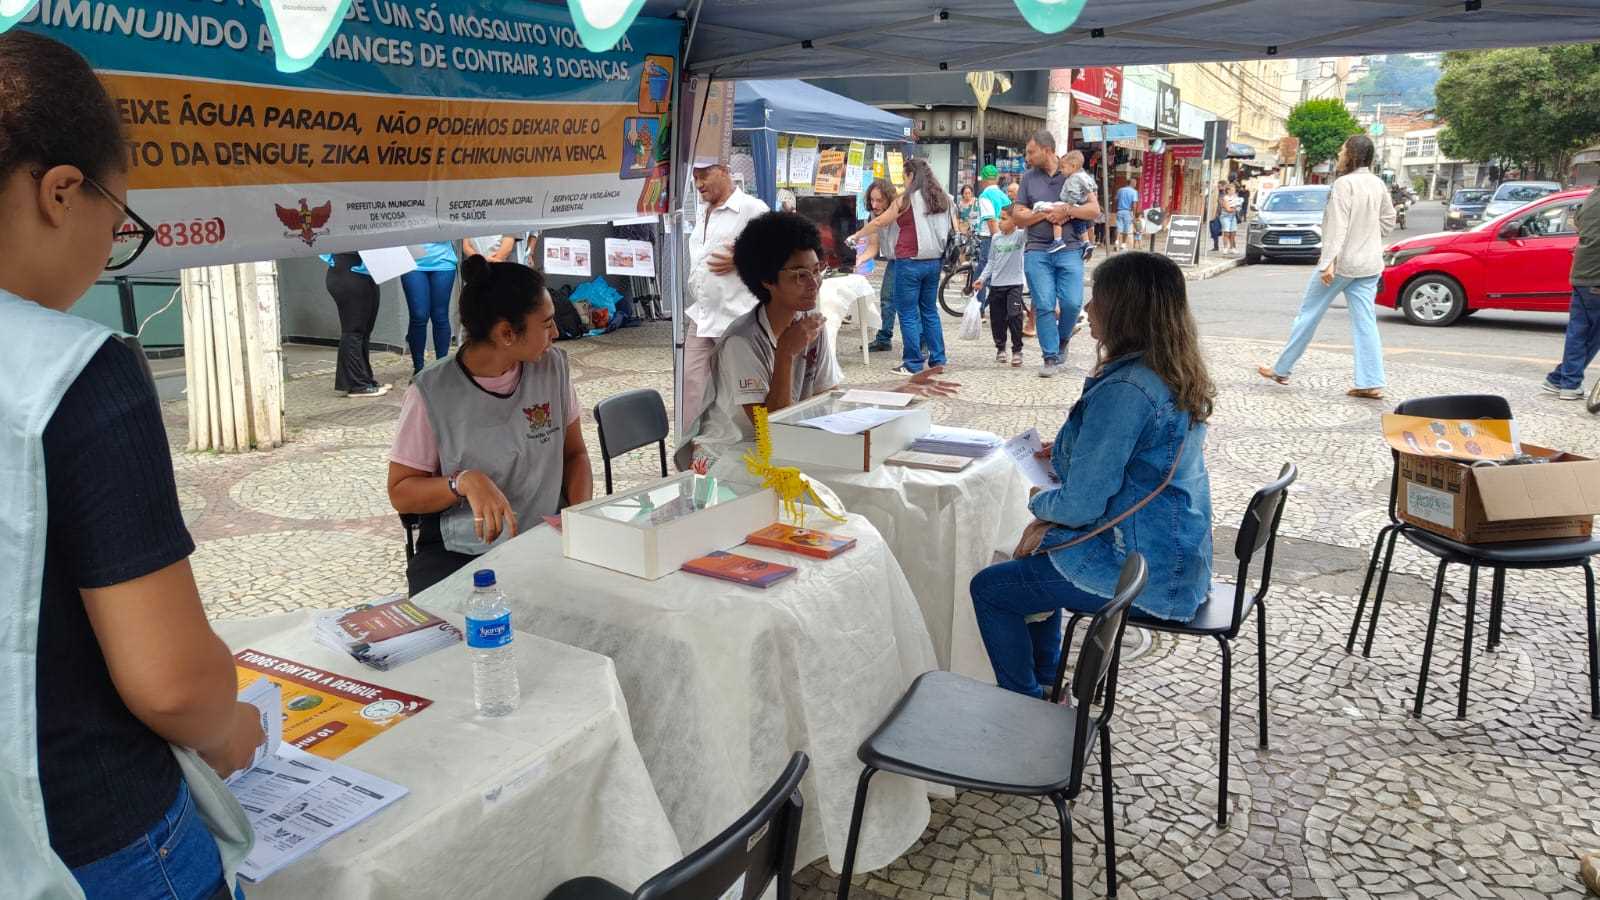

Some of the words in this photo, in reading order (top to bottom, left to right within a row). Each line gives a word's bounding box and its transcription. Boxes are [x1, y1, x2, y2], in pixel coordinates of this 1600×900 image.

[373, 0, 414, 29] UM
[415, 3, 445, 34] SÓ
[449, 13, 547, 45] MOSQUITO
[549, 26, 586, 48] VOC
[257, 23, 275, 52] A
[328, 33, 415, 66] ANCES
[420, 42, 448, 69] DE
[452, 46, 539, 76] CONTRAIR
[543, 55, 553, 77] 3
[556, 57, 631, 82] DOENÇAS.
[114, 97, 171, 125] EIXE
[180, 93, 255, 127] ÁGUA
[263, 106, 363, 136] PARADA,
[376, 110, 421, 135] NÃO
[426, 117, 507, 136] PODEMOS
[511, 118, 560, 135] DEIXAR
[562, 118, 588, 135] QUE
[590, 118, 600, 134] O
[170, 141, 210, 166] DA
[214, 141, 314, 168] DENGUE,
[320, 143, 370, 165] ZIKA
[377, 140, 432, 165] VÍRUS
[436, 147, 446, 165] E
[451, 146, 562, 165] CHIKUNGUNYA
[565, 145, 607, 163] VENÇA.
[346, 200, 387, 211] PREFEITURA
[388, 198, 425, 210] MUNICIPAL
[449, 198, 493, 210] SECRETARIA
[495, 195, 533, 207] MUNICIPAL
[461, 208, 487, 221] SAÚDE
[370, 212, 380, 222] DE
[238, 652, 279, 668] TODOS
[273, 662, 324, 682] CONTRA
[318, 677, 334, 686] A
